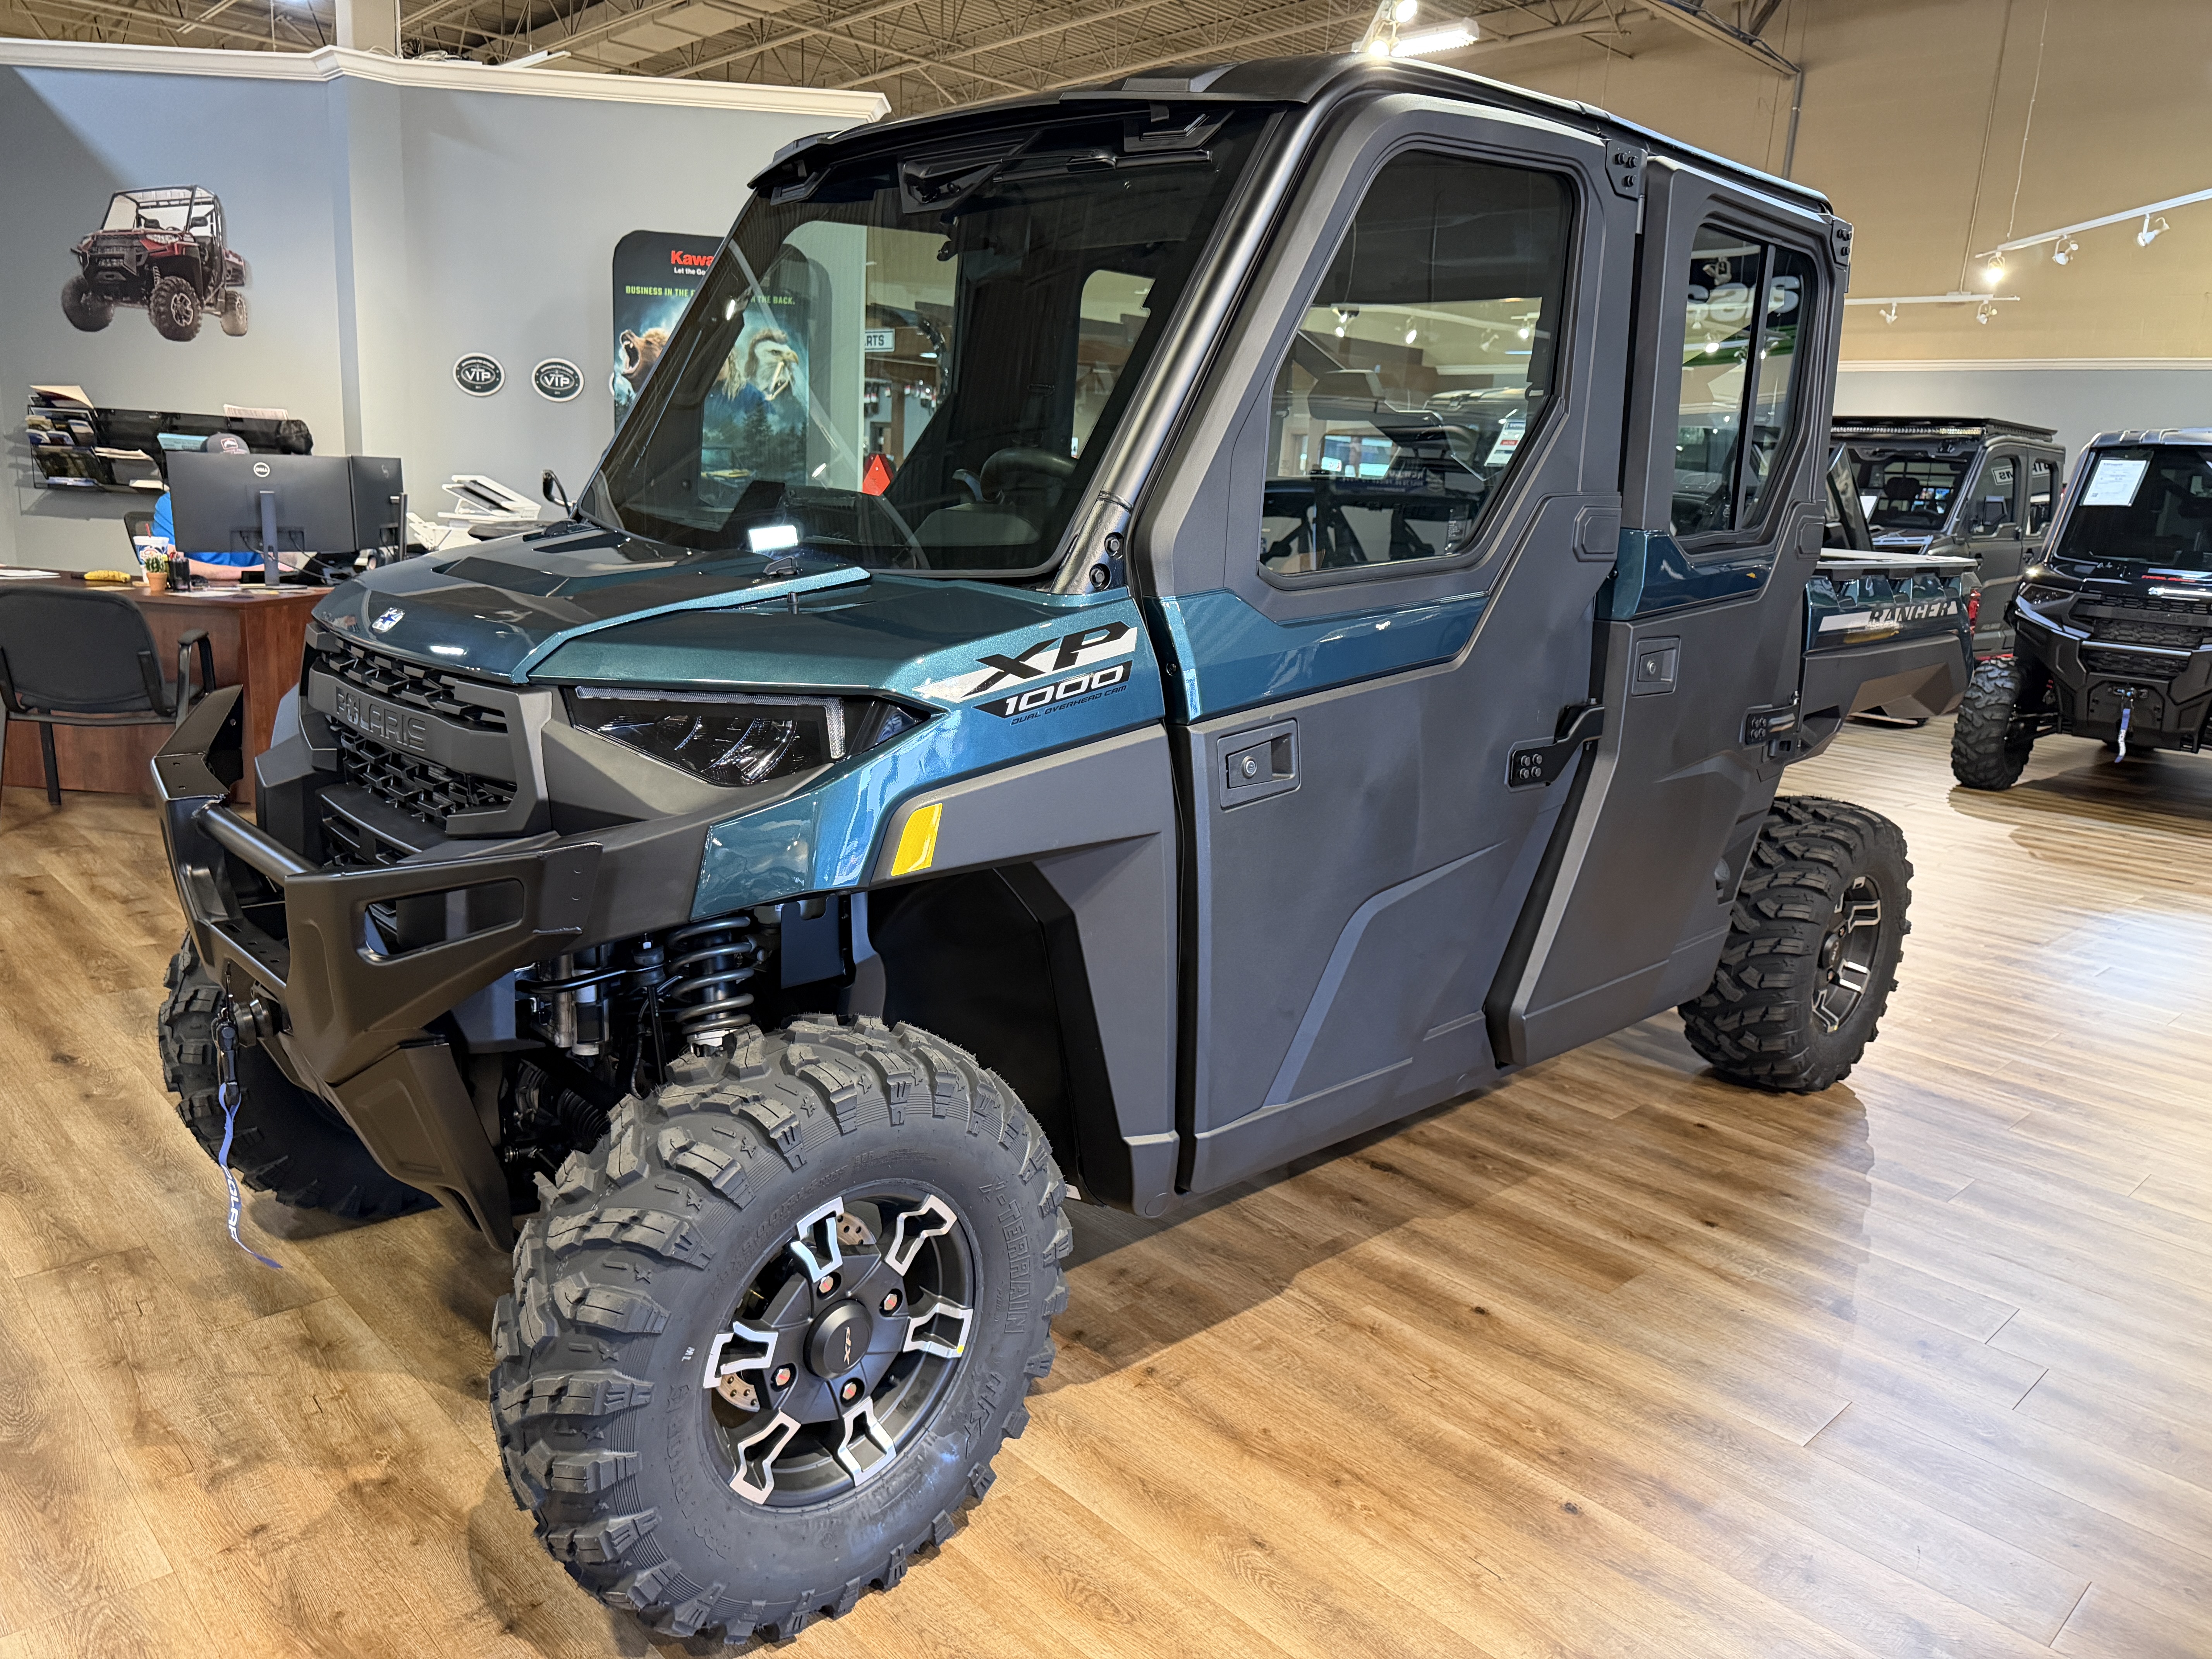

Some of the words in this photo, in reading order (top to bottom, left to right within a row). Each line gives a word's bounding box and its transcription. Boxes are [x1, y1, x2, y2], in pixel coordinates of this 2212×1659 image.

[671, 250, 714, 267] Kawa
[625, 285, 663, 295] BUSINESS
[665, 288, 672, 296] IN
[675, 289, 689, 297] THE
[757, 295, 771, 304] THE
[773, 296, 795, 305] BACK.
[865, 335, 884, 346] RTS
[465, 370, 491, 381] VIP
[544, 376, 570, 387] VIP
[1868, 601, 1953, 624] RANGER
[960, 621, 1131, 699] XP
[1005, 665, 1124, 716] 1000
[1011, 711, 1041, 725] DUAL
[1044, 693, 1102, 714] OVERHEAD
[1104, 685, 1127, 696] CAM
[336, 686, 426, 751] POLARIS
[220, 1164, 254, 1254] POLAR
[979, 1174, 1031, 1333] X-TERRAIN
[843, 1326, 852, 1365] XP
